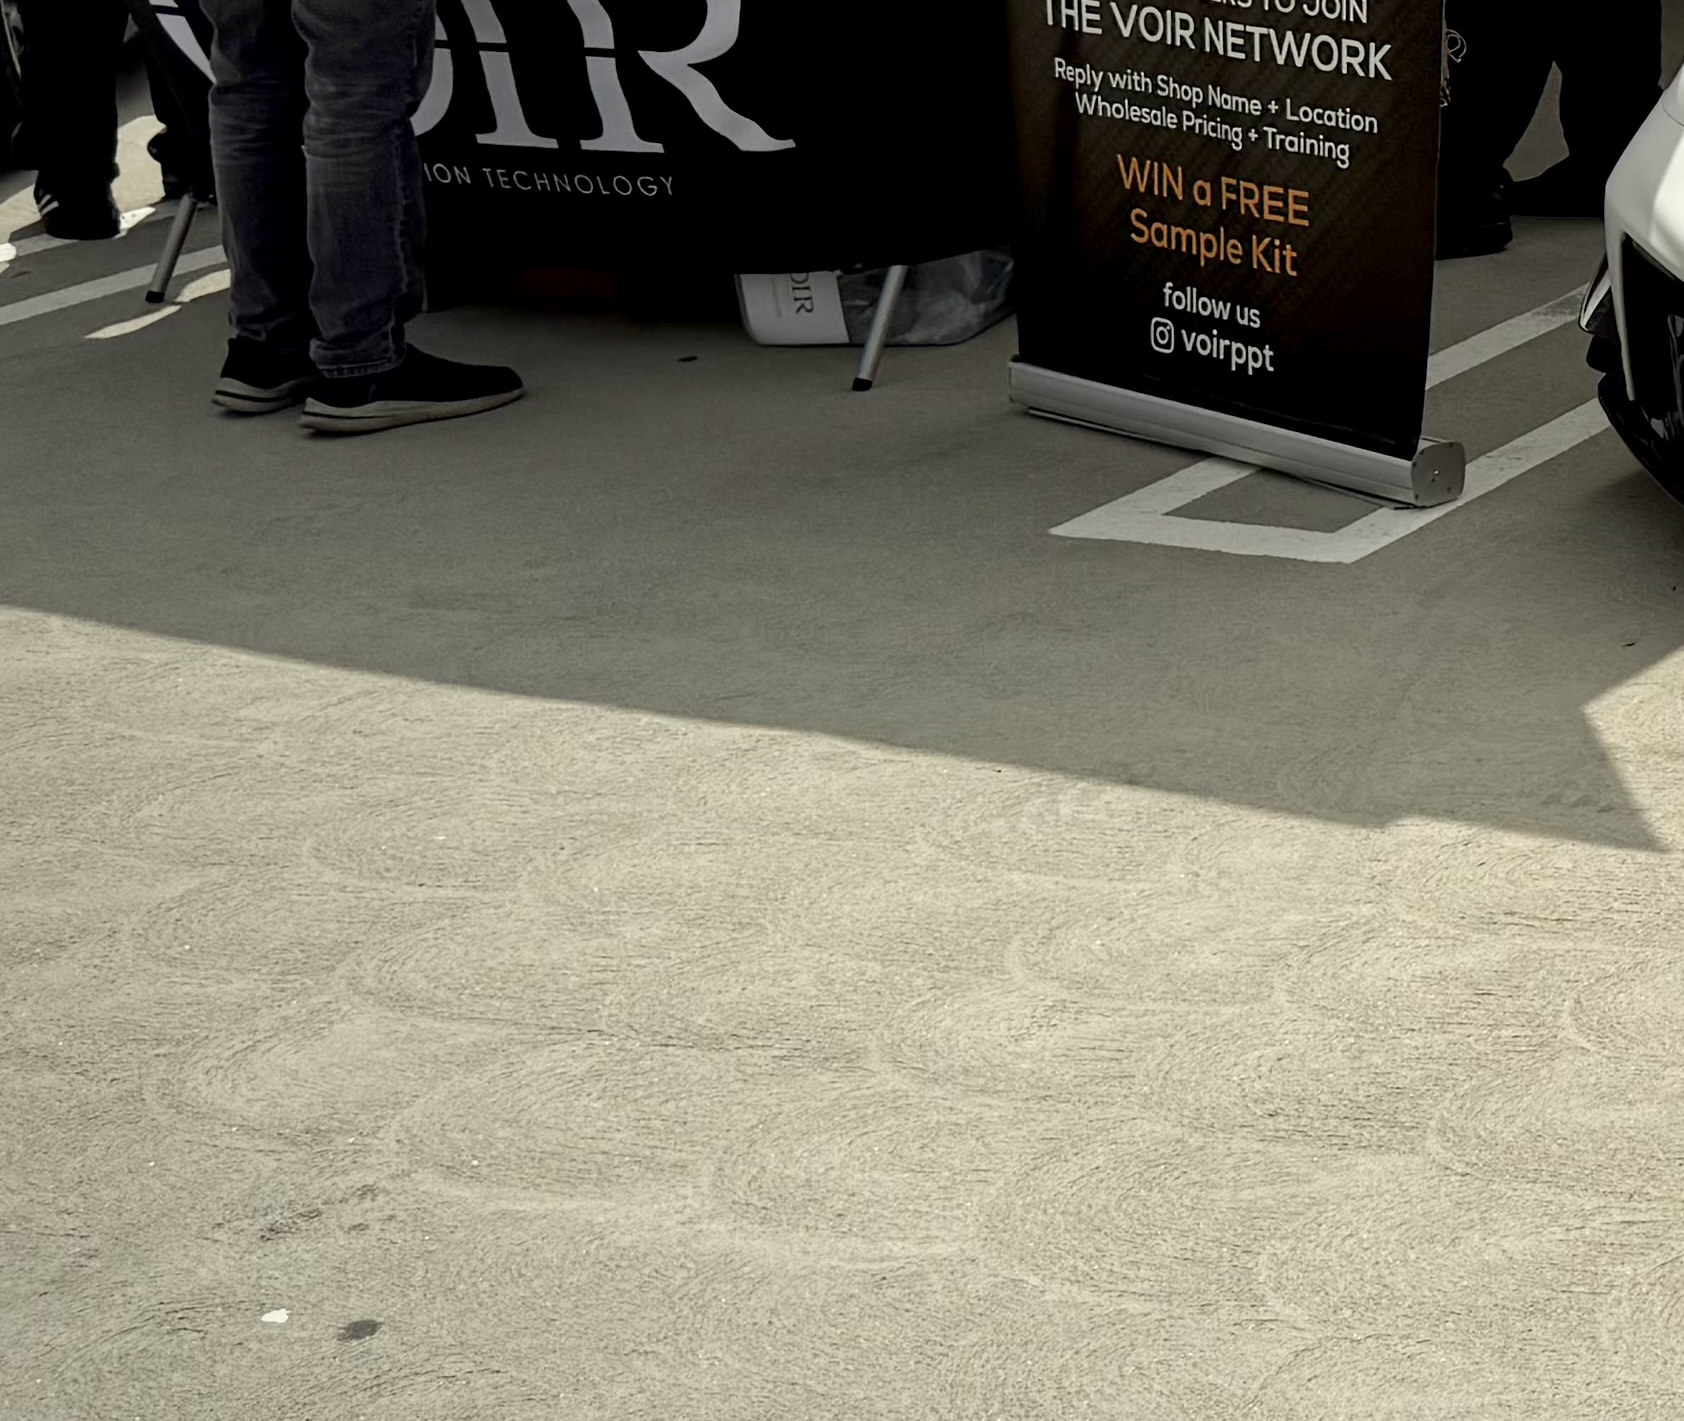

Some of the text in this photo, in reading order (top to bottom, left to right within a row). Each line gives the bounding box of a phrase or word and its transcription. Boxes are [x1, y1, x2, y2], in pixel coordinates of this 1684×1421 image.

[1110, 1, 1196, 50] VOIR
[1204, 17, 1393, 81] NETWORK
[1054, 57, 1378, 134] Reply with Shop Name + Location
[1075, 92, 1350, 169] Wholesale Pricing + Training
[483, 168, 673, 197] TECHNOLOGY
[1116, 153, 1310, 227] WIN a FREE
[1130, 208, 1298, 277] Sample Kit
[790, 273, 814, 315] OIR
[1163, 282, 1261, 328] follow us
[1181, 329, 1274, 375] voirppt
